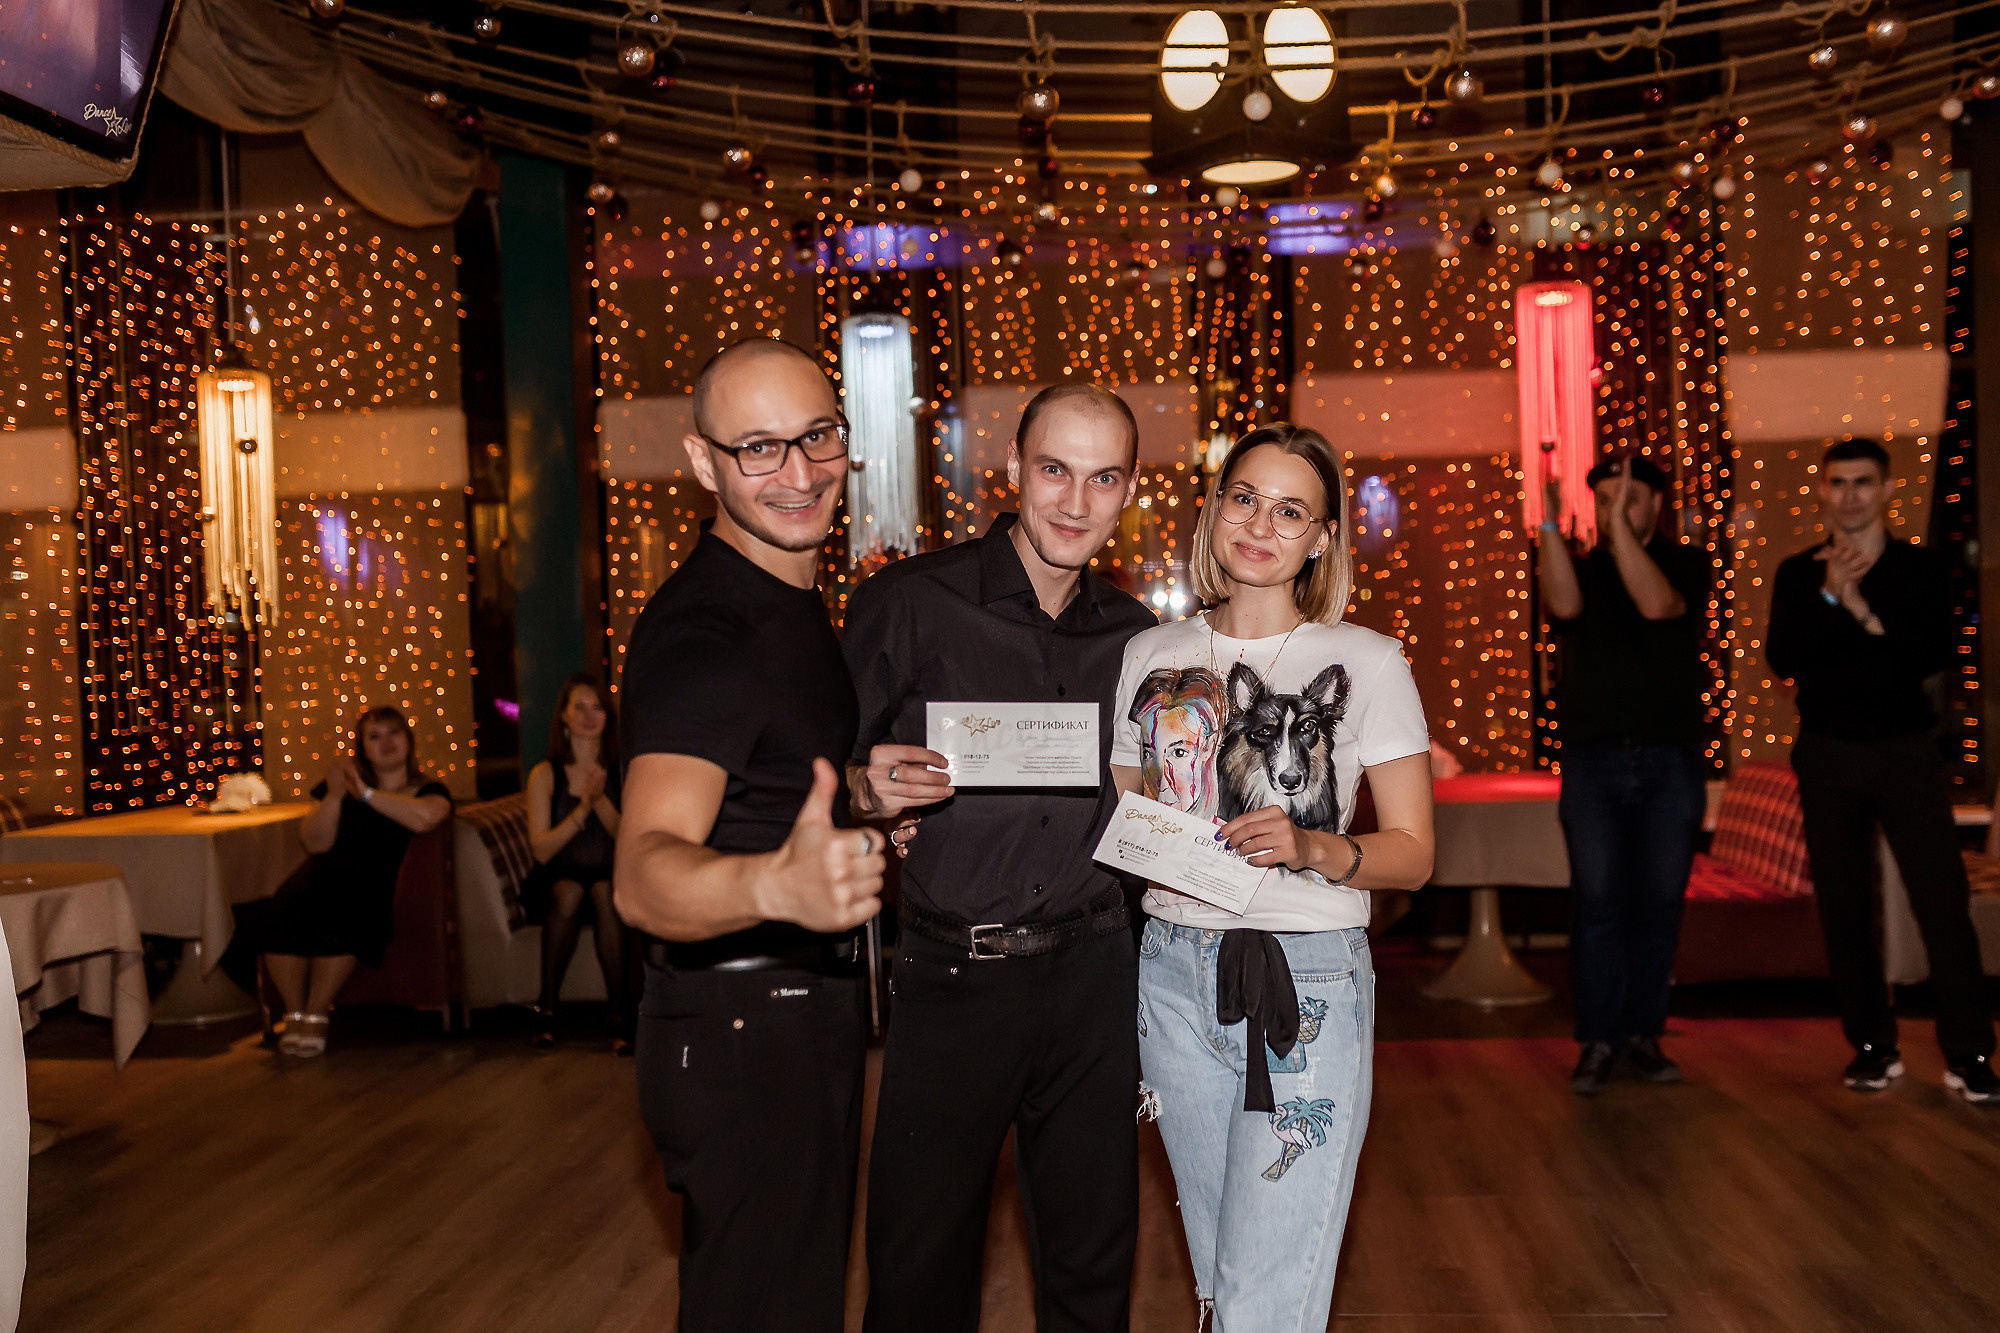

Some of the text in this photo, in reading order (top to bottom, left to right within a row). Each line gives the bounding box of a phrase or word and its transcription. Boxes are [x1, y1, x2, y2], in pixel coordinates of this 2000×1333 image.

[84, 103, 112, 120] Dance
[1016, 720, 1089, 730] СЕРТИФИКАТ
[1125, 808, 1157, 821] Dance
